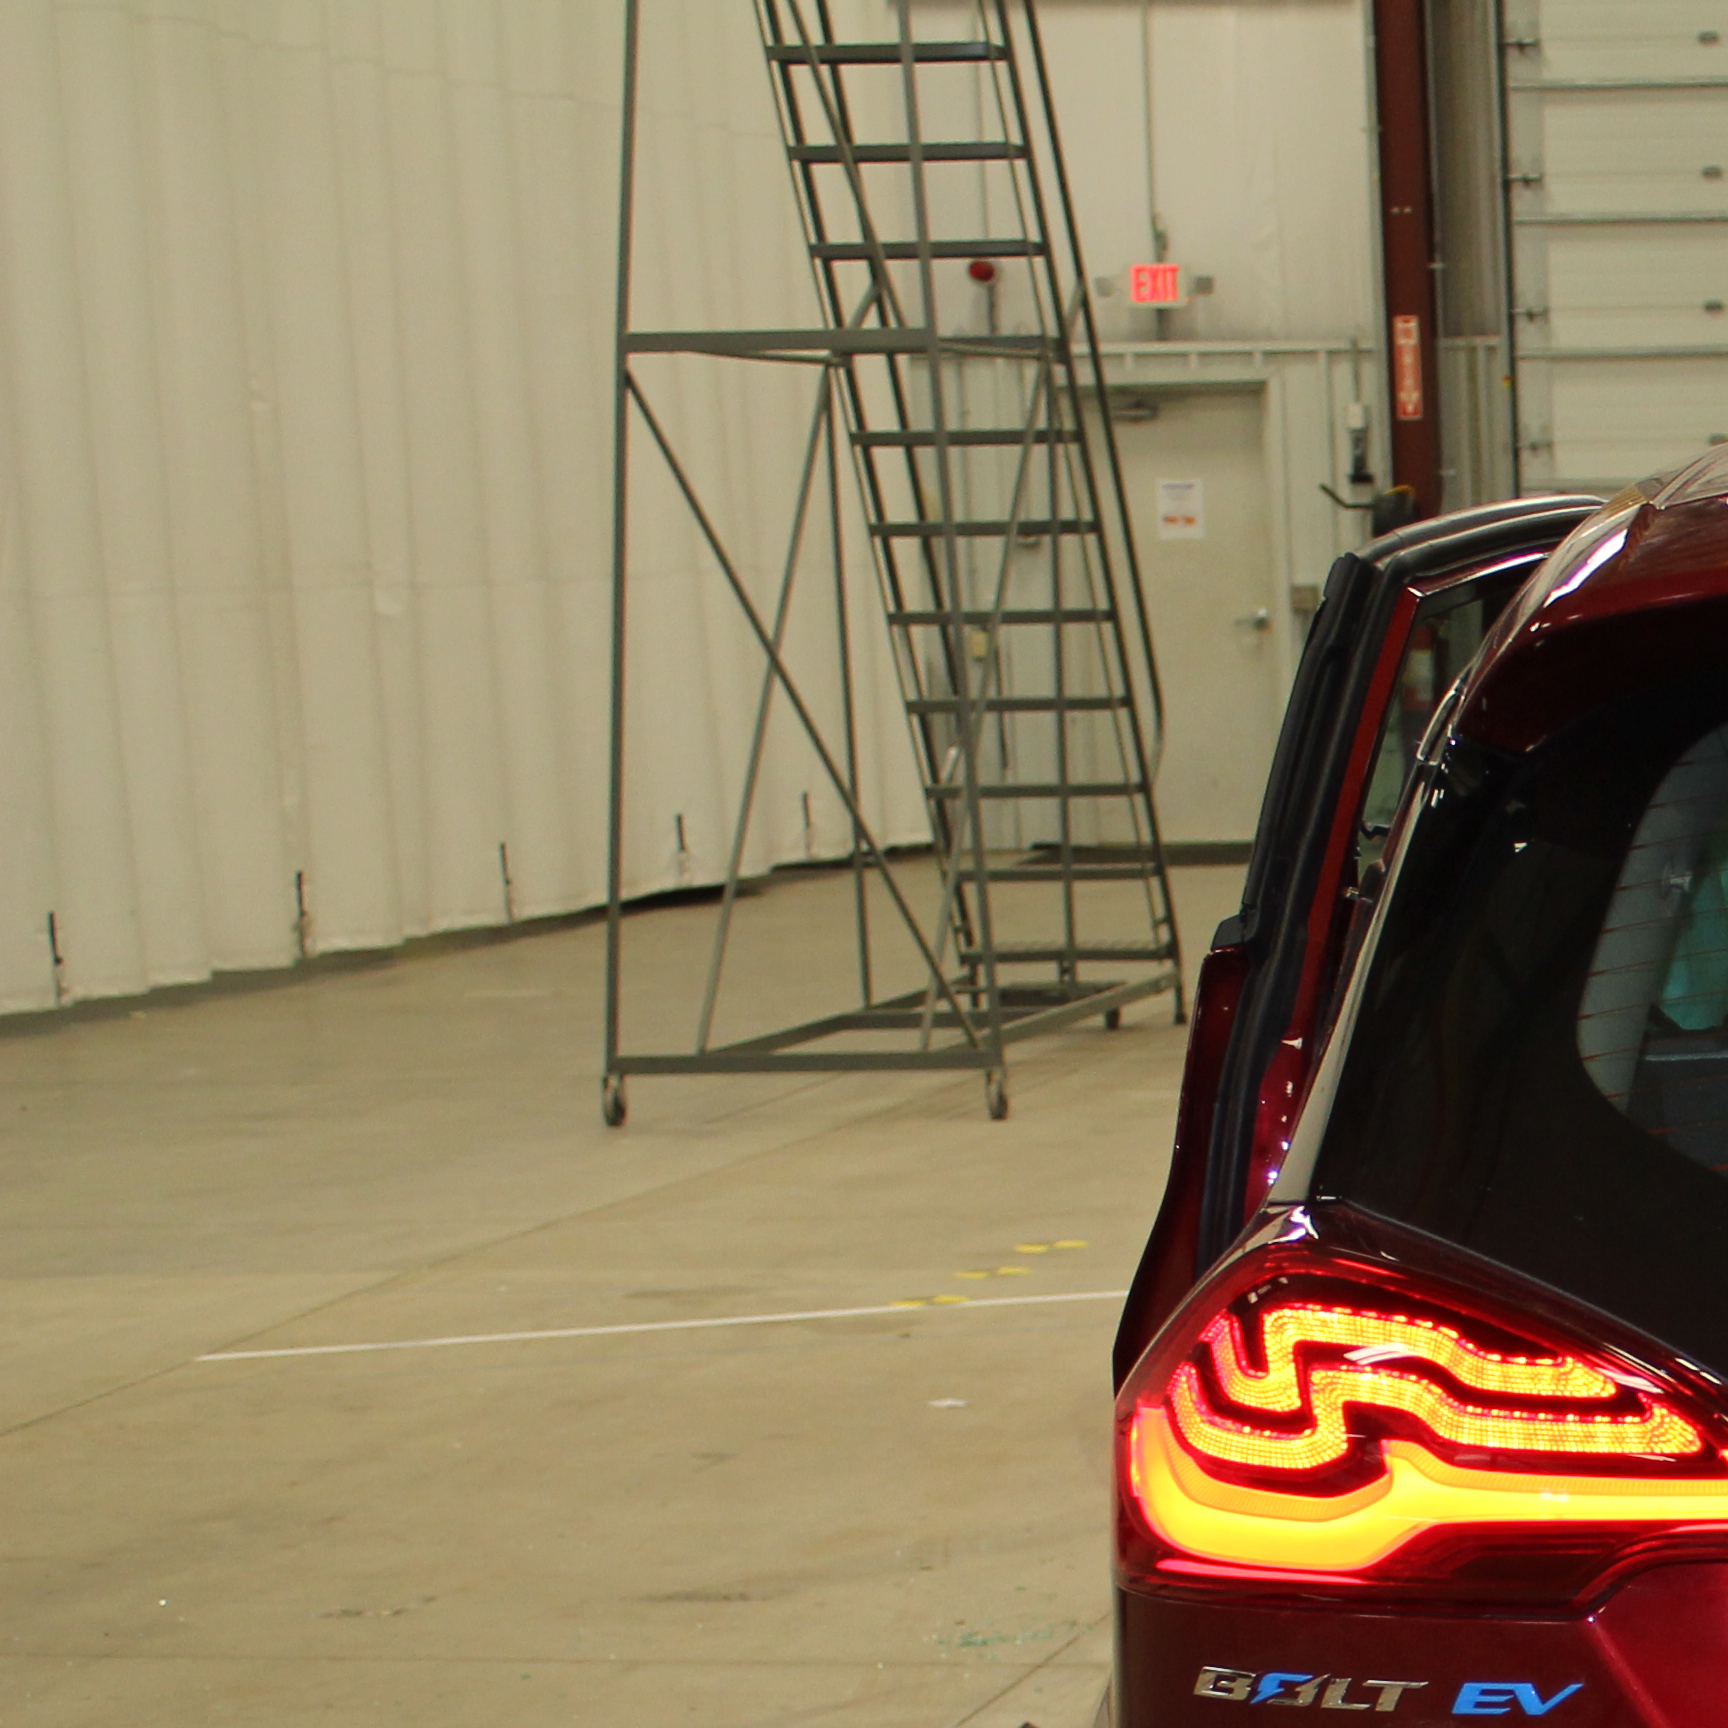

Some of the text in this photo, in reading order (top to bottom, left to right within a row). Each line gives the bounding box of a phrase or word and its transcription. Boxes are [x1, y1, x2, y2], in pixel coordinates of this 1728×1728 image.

[1131, 264, 1179, 301] EXIT
[1194, 1665, 1585, 1716] BOLT EV
